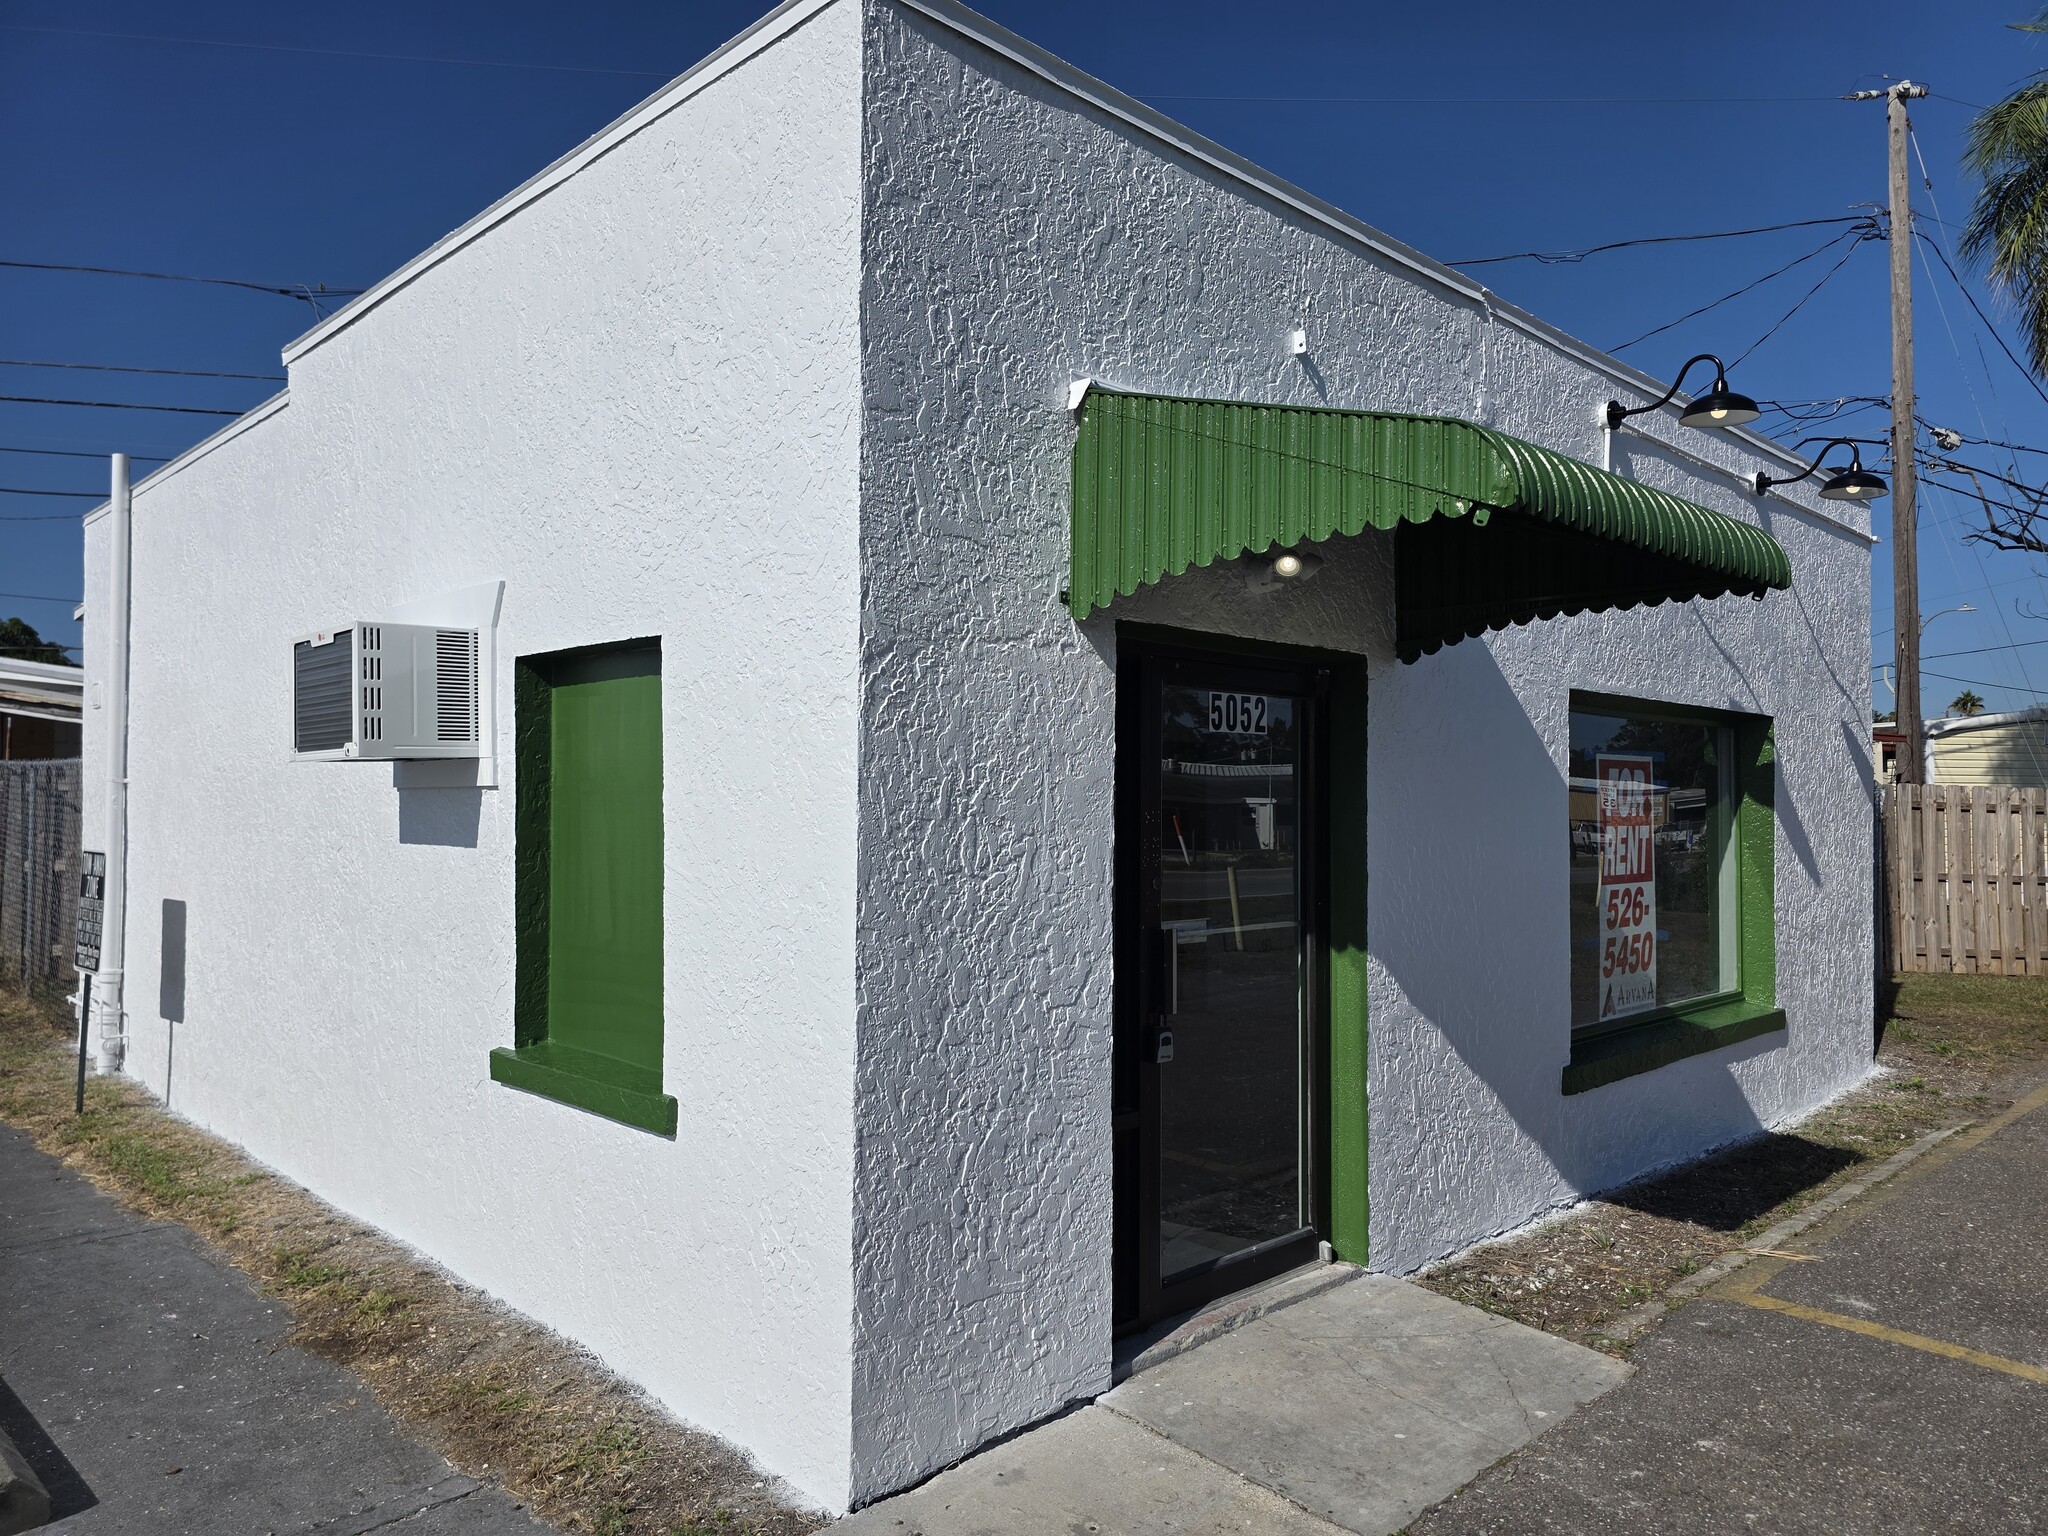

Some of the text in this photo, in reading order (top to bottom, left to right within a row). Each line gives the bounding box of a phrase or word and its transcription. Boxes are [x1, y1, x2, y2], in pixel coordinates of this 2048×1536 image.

[1211, 693, 1266, 733] 5052
[1605, 767, 1646, 818] FOR
[1603, 825, 1650, 876] RENT
[1606, 886, 1650, 930] 526-
[1602, 931, 1653, 978] 5450
